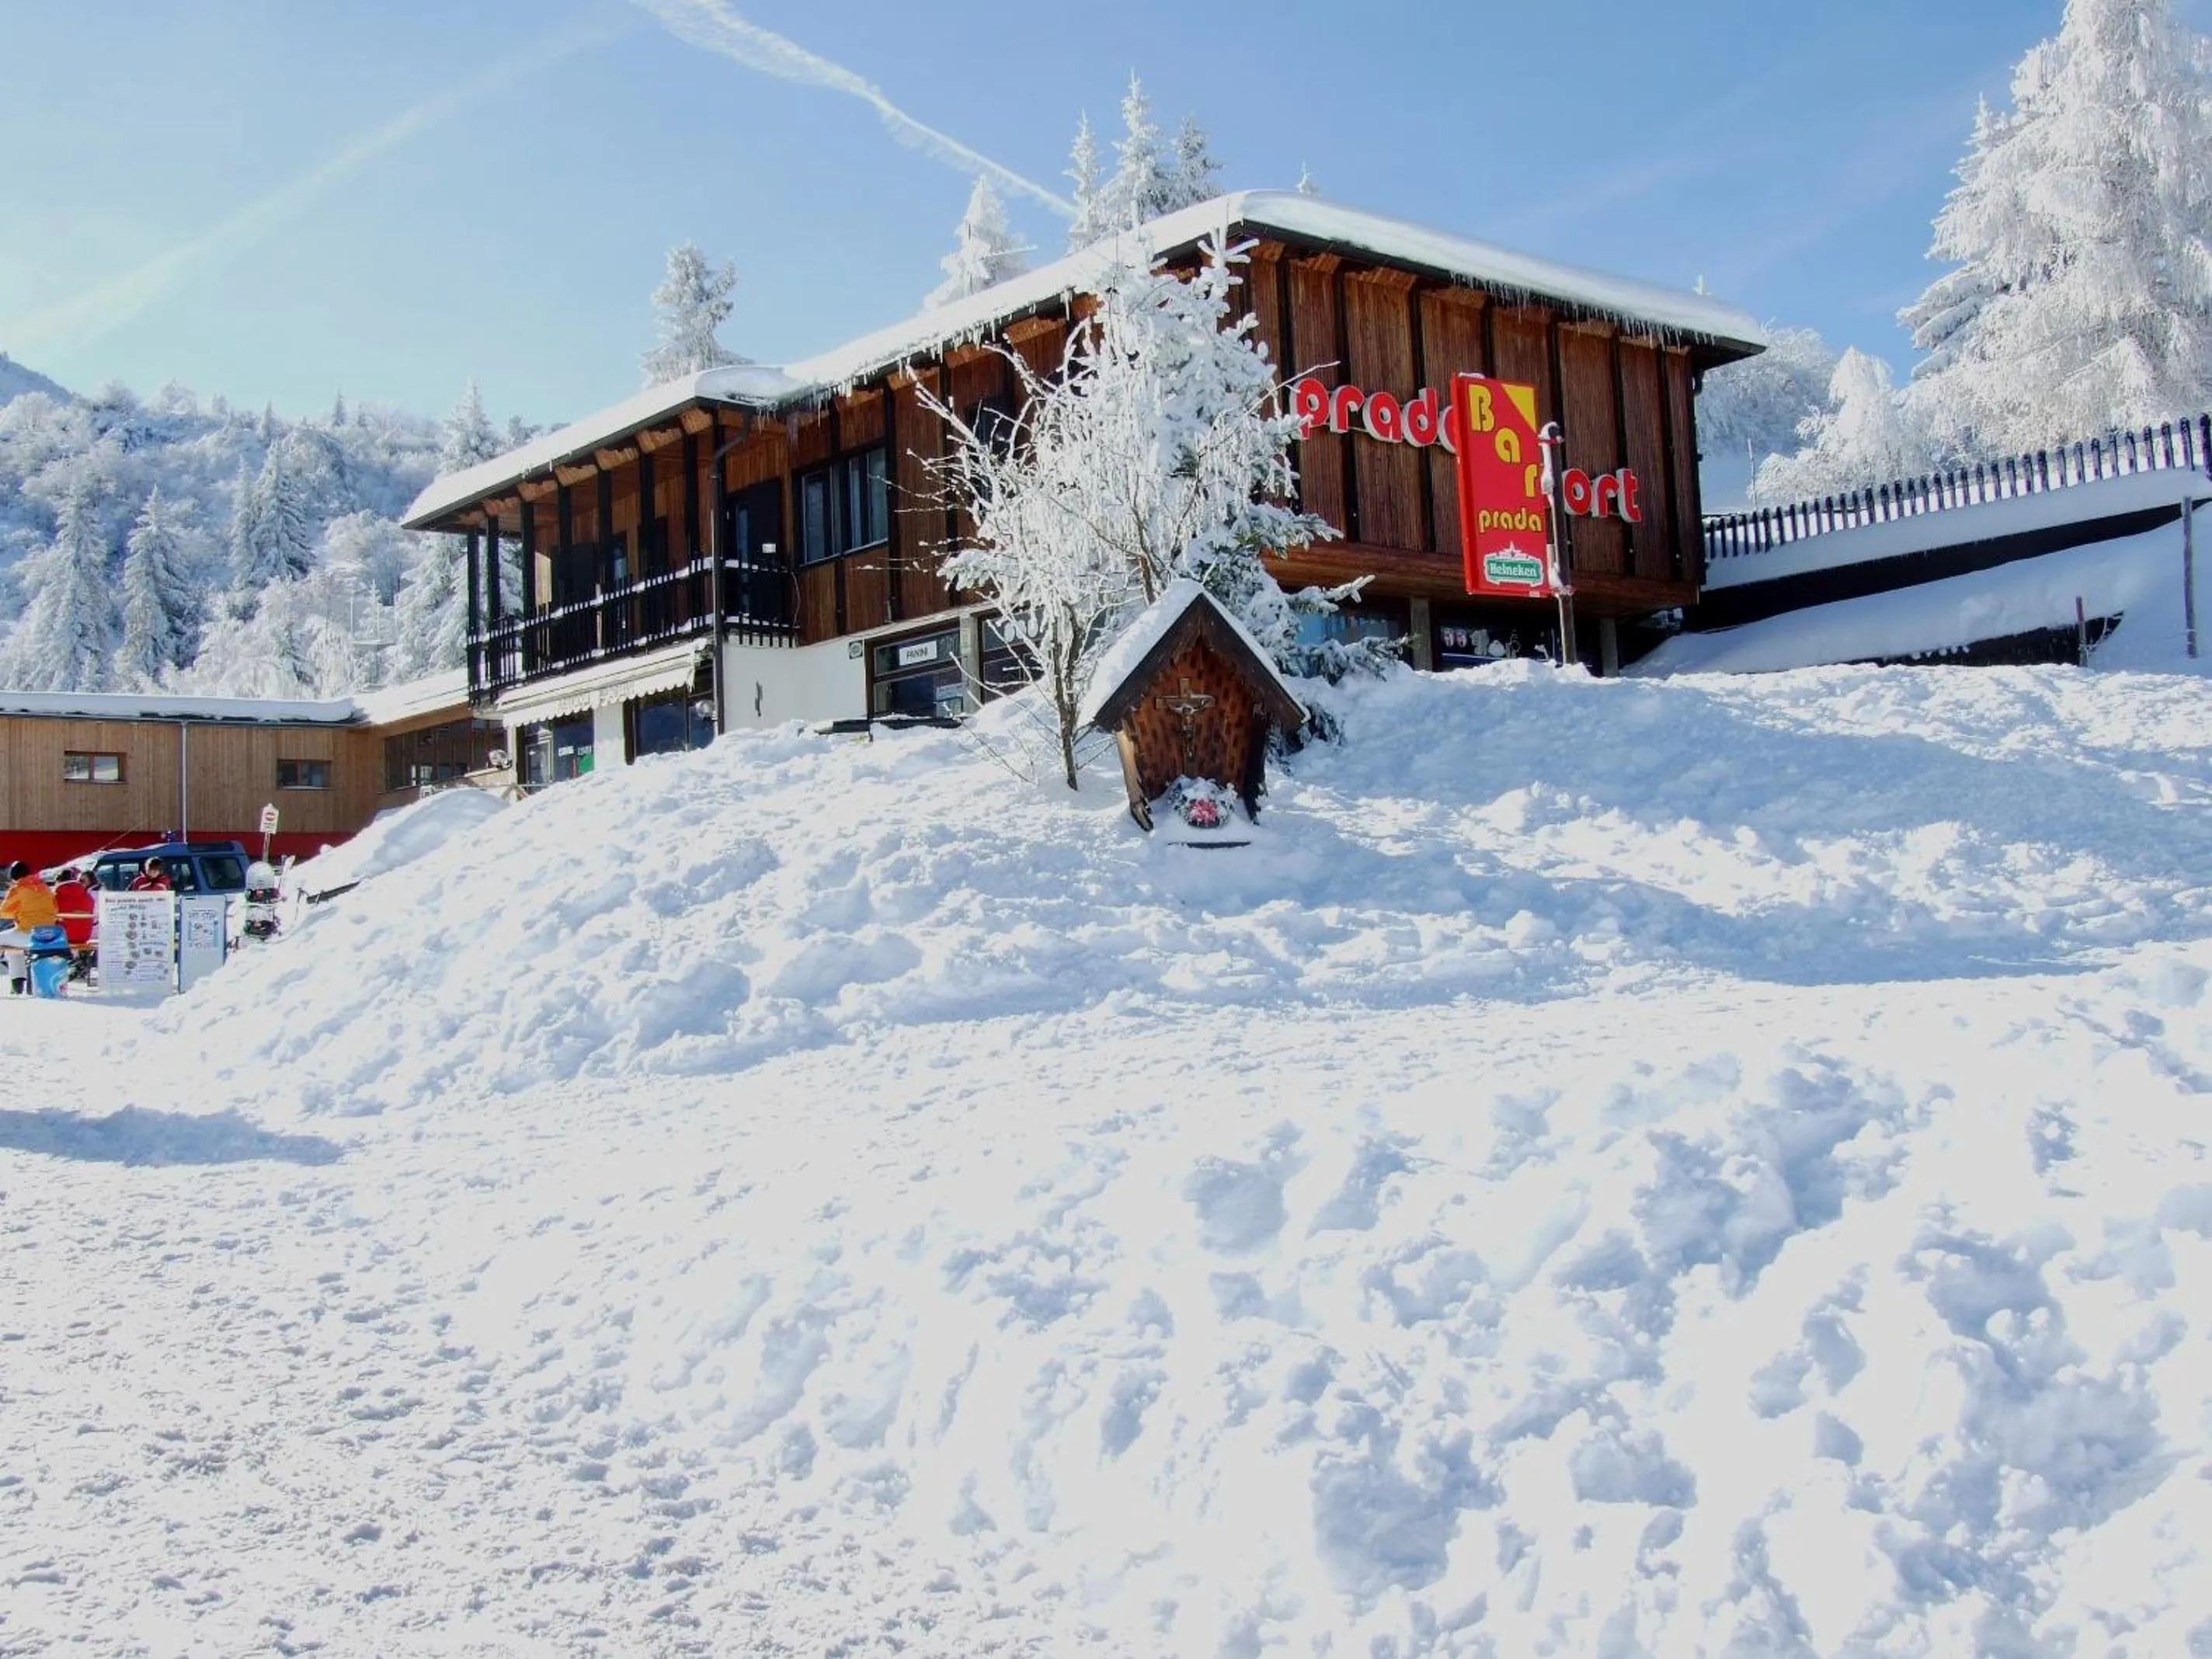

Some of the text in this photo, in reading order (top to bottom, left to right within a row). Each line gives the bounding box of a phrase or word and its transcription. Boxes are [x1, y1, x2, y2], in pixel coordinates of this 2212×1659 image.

[1468, 384, 1538, 498] Bar
[1561, 468, 1642, 523] ort
[1478, 506, 1542, 533] prada
[1489, 562, 1538, 577] Heineken
